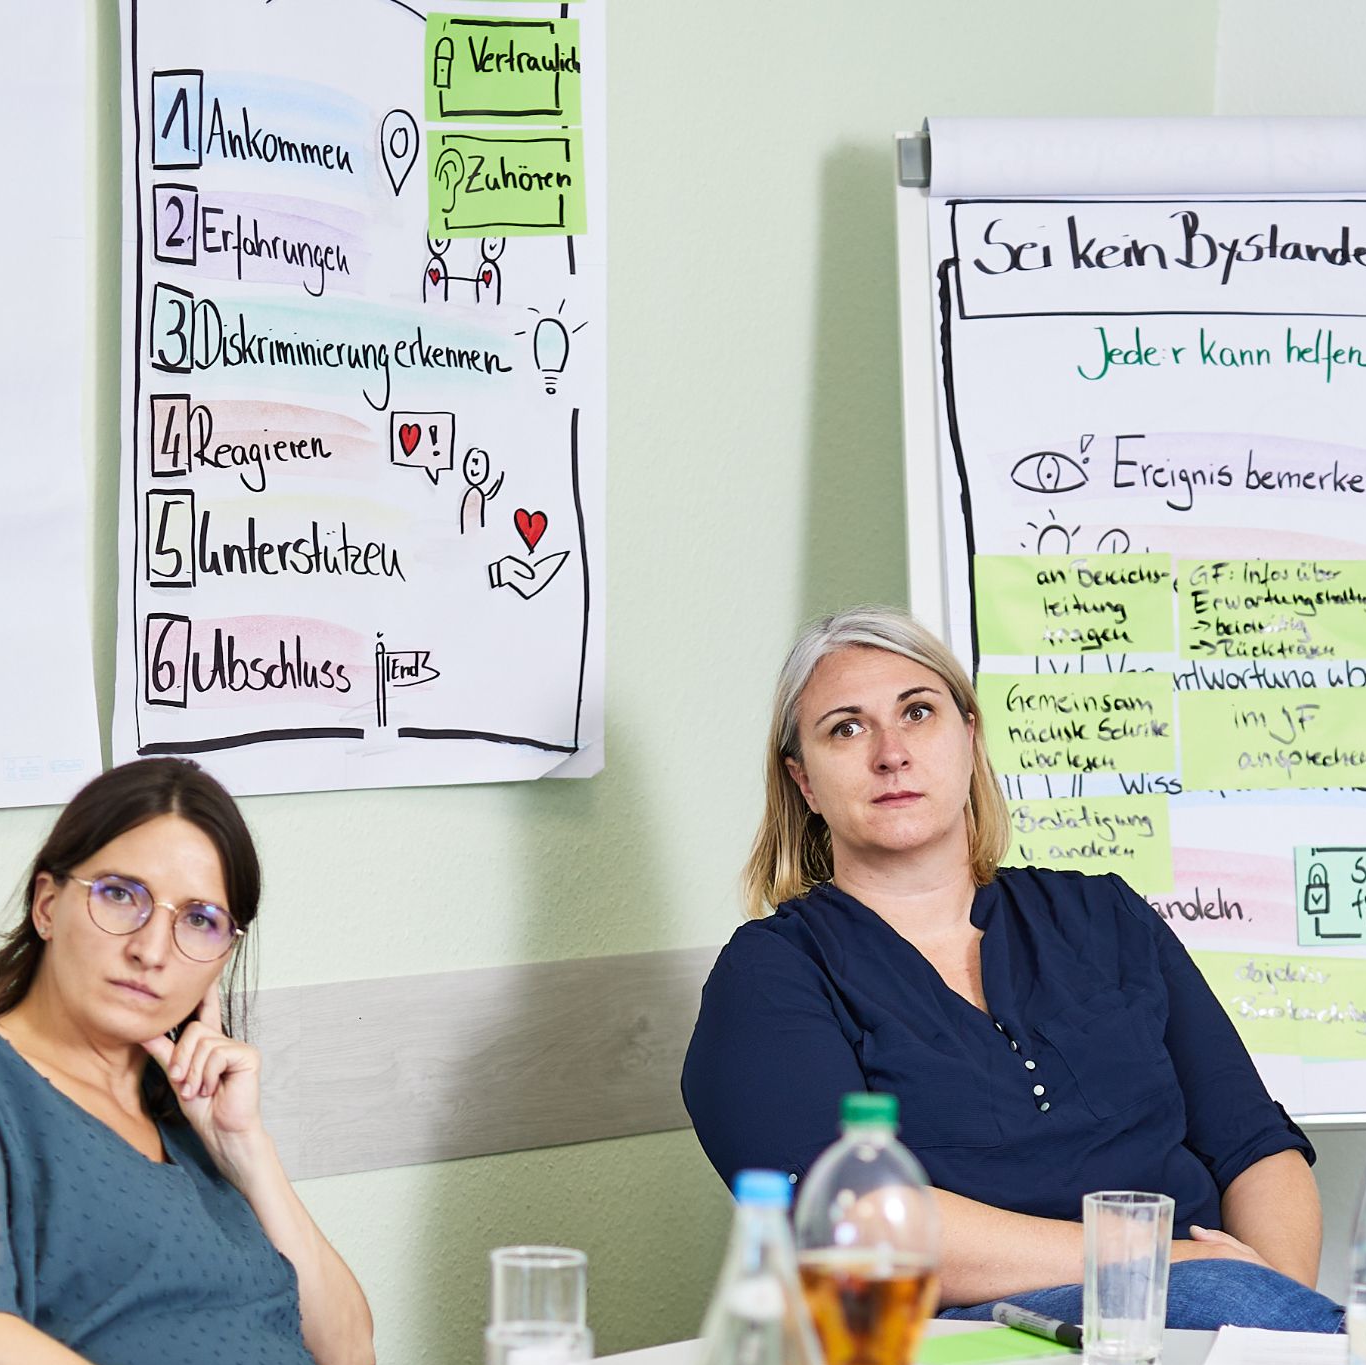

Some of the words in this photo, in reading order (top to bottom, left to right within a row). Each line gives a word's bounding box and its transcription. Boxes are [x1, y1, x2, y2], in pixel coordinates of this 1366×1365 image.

[206, 97, 354, 174] Ankommen
[465, 155, 572, 195] Zuhören
[201, 206, 350, 297] Erfahrungen
[974, 218, 1053, 276] Sei
[1069, 215, 1167, 271] kein
[193, 298, 391, 411] Diskriminierung
[397, 326, 513, 374] erkennen
[1199, 327, 1271, 368] kann
[188, 405, 332, 492] Reagieren
[1113, 433, 1234, 511] Ereignis
[198, 510, 407, 582] Unterstützen
[1036, 569, 1066, 586] an
[1243, 562, 1289, 587] Infos
[191, 629, 352, 694] Abschluss
[1006, 683, 1154, 715] Gemeinsam
[1144, 887, 1253, 922] andeln.
